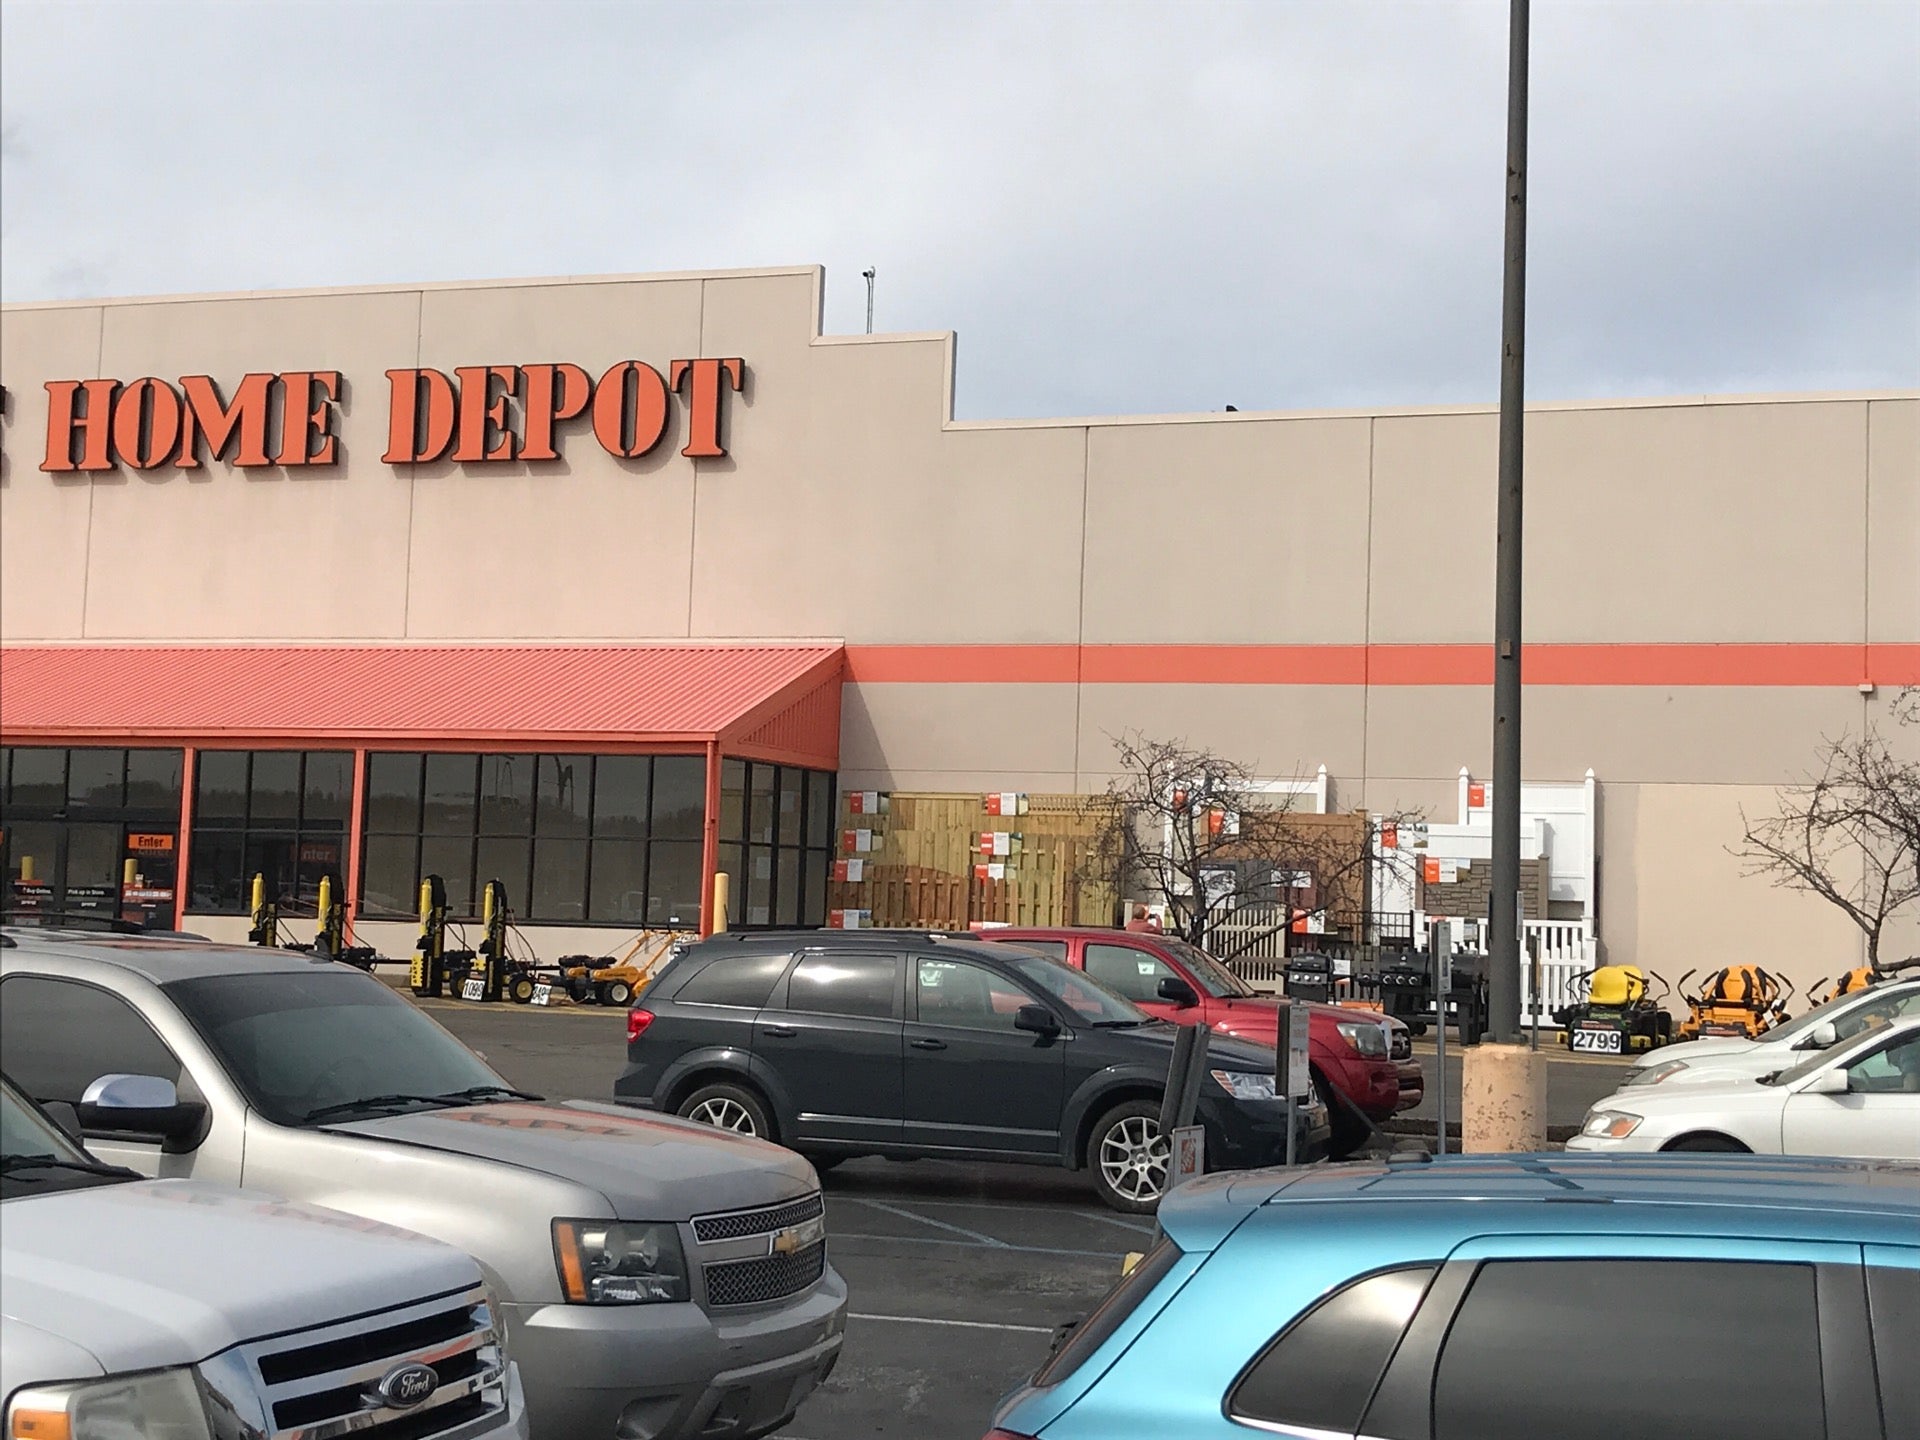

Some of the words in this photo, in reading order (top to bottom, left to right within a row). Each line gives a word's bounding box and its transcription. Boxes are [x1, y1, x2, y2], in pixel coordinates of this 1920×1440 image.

[39, 370, 347, 472] HOME
[380, 357, 746, 465] DEPOT
[138, 836, 164, 848] Enter
[1574, 1031, 1621, 1050] 2799
[401, 1371, 430, 1398] Ford
